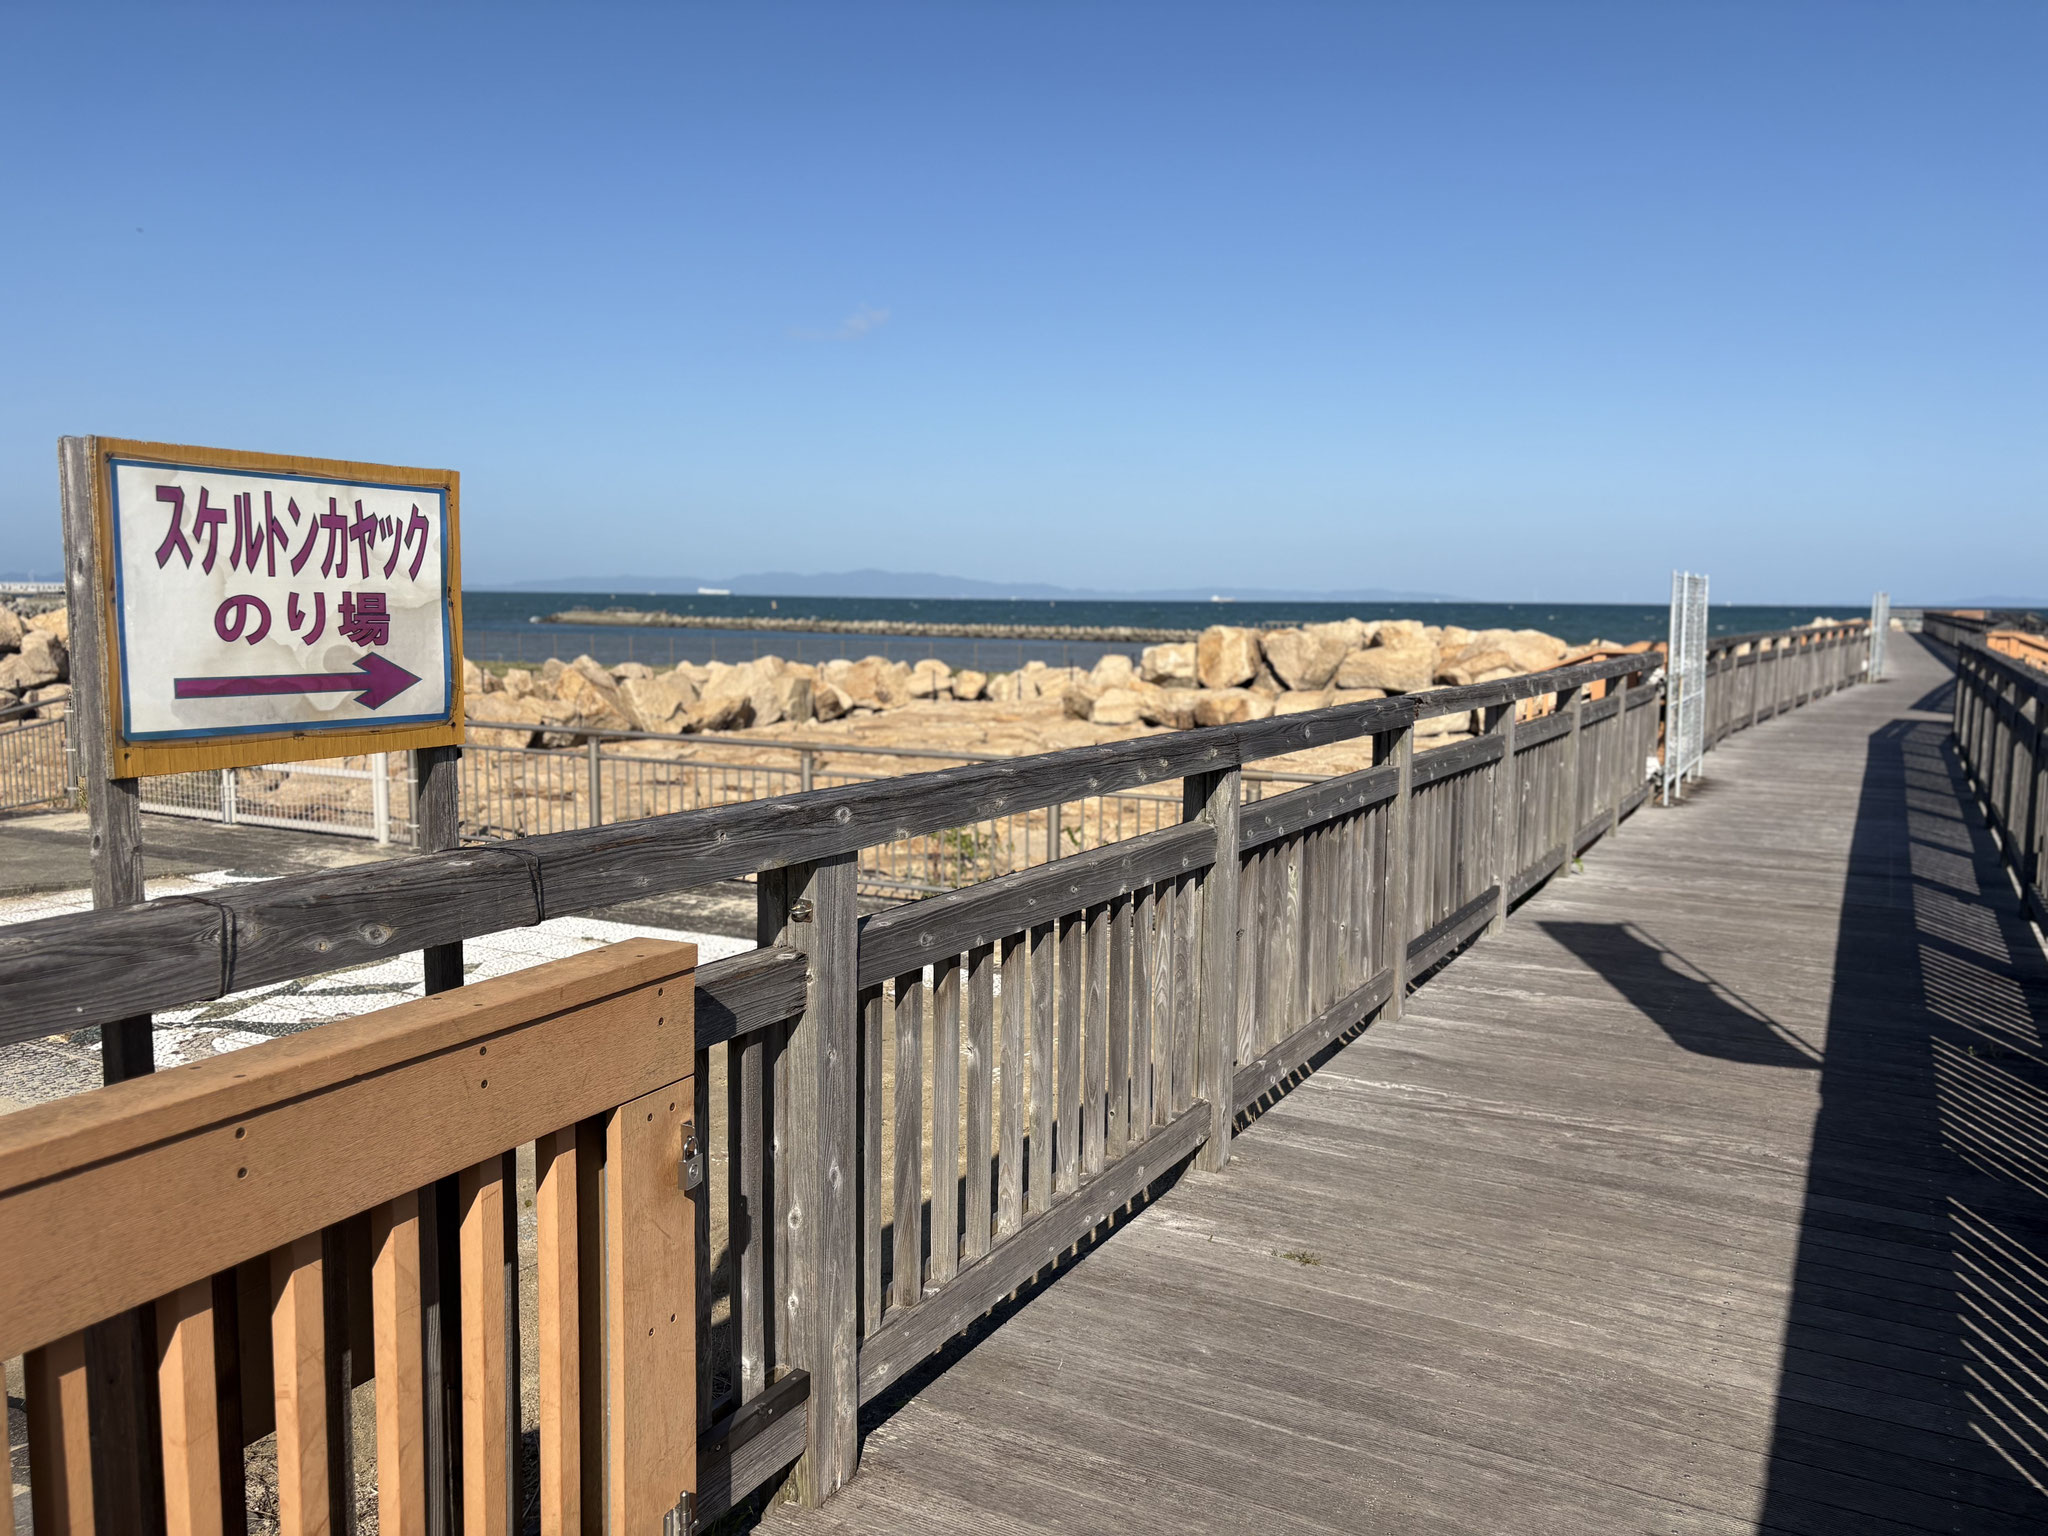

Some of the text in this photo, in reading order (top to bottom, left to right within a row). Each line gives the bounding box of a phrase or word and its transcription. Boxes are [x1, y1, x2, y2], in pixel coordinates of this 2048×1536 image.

[155, 484, 430, 582] スケルトンカヤック
[214, 591, 391, 646] のり場
